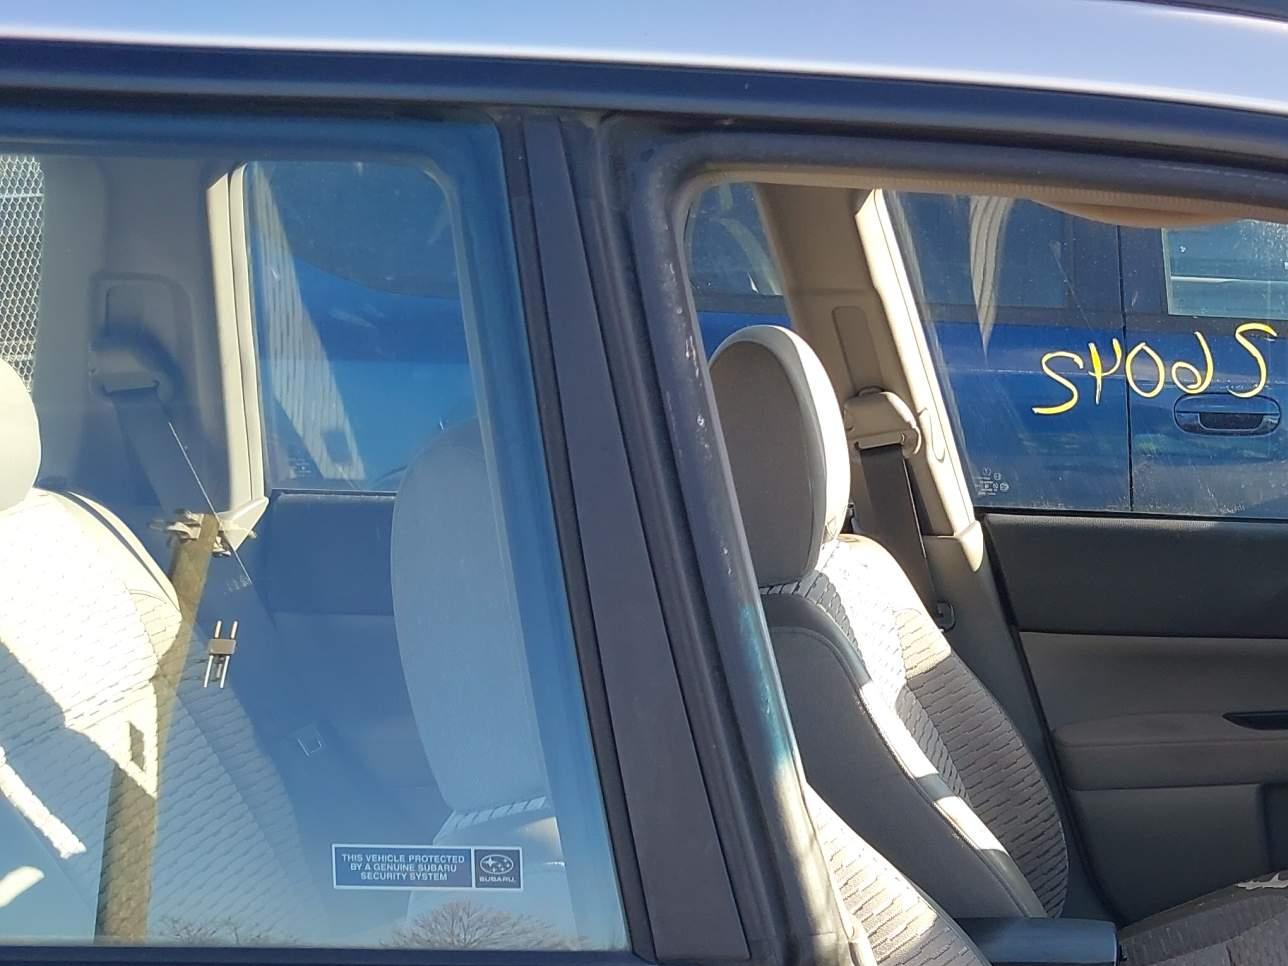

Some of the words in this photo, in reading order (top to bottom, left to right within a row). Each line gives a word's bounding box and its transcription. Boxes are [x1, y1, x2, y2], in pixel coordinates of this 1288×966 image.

[342, 854, 363, 862] THIS
[366, 854, 406, 863] VEHICLE
[408, 855, 465, 864] PROTECTED
[350, 863, 363, 871] BY
[373, 864, 415, 872] GENUINE
[418, 864, 457, 873] SUBARU
[360, 872, 407, 880] SECURITY
[409, 872, 448, 881] SYSTEM
